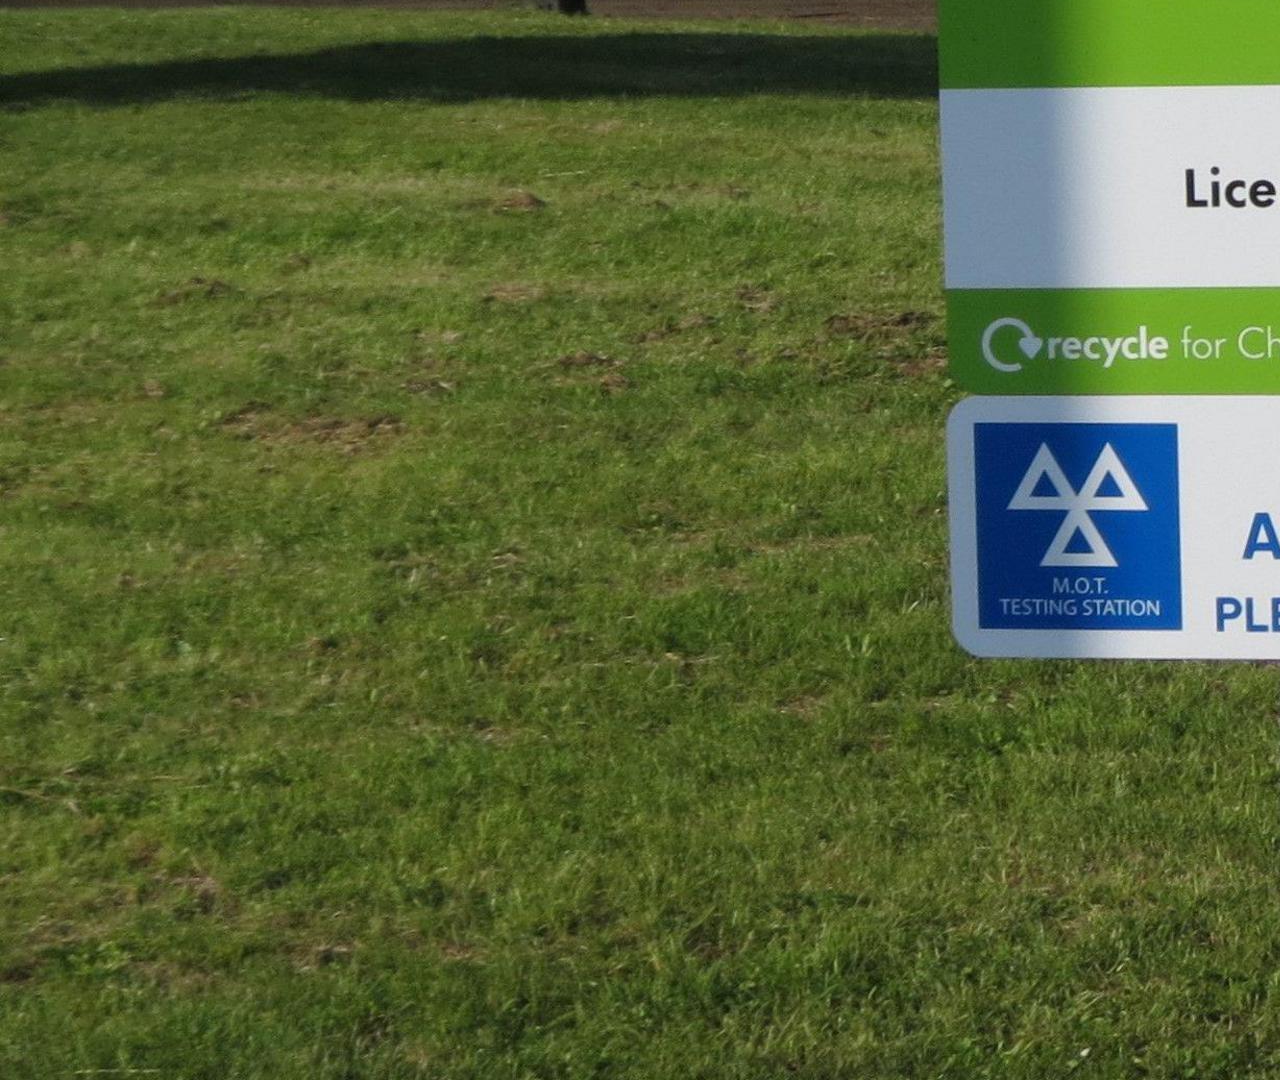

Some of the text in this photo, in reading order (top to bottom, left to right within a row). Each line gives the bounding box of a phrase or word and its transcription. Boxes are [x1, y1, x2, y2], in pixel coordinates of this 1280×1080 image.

[1047, 325, 1169, 368] recycle
[1181, 326, 1226, 359] for
[1053, 577, 1108, 594] M.O.T.
[1000, 599, 1160, 616] TESTING STATION
